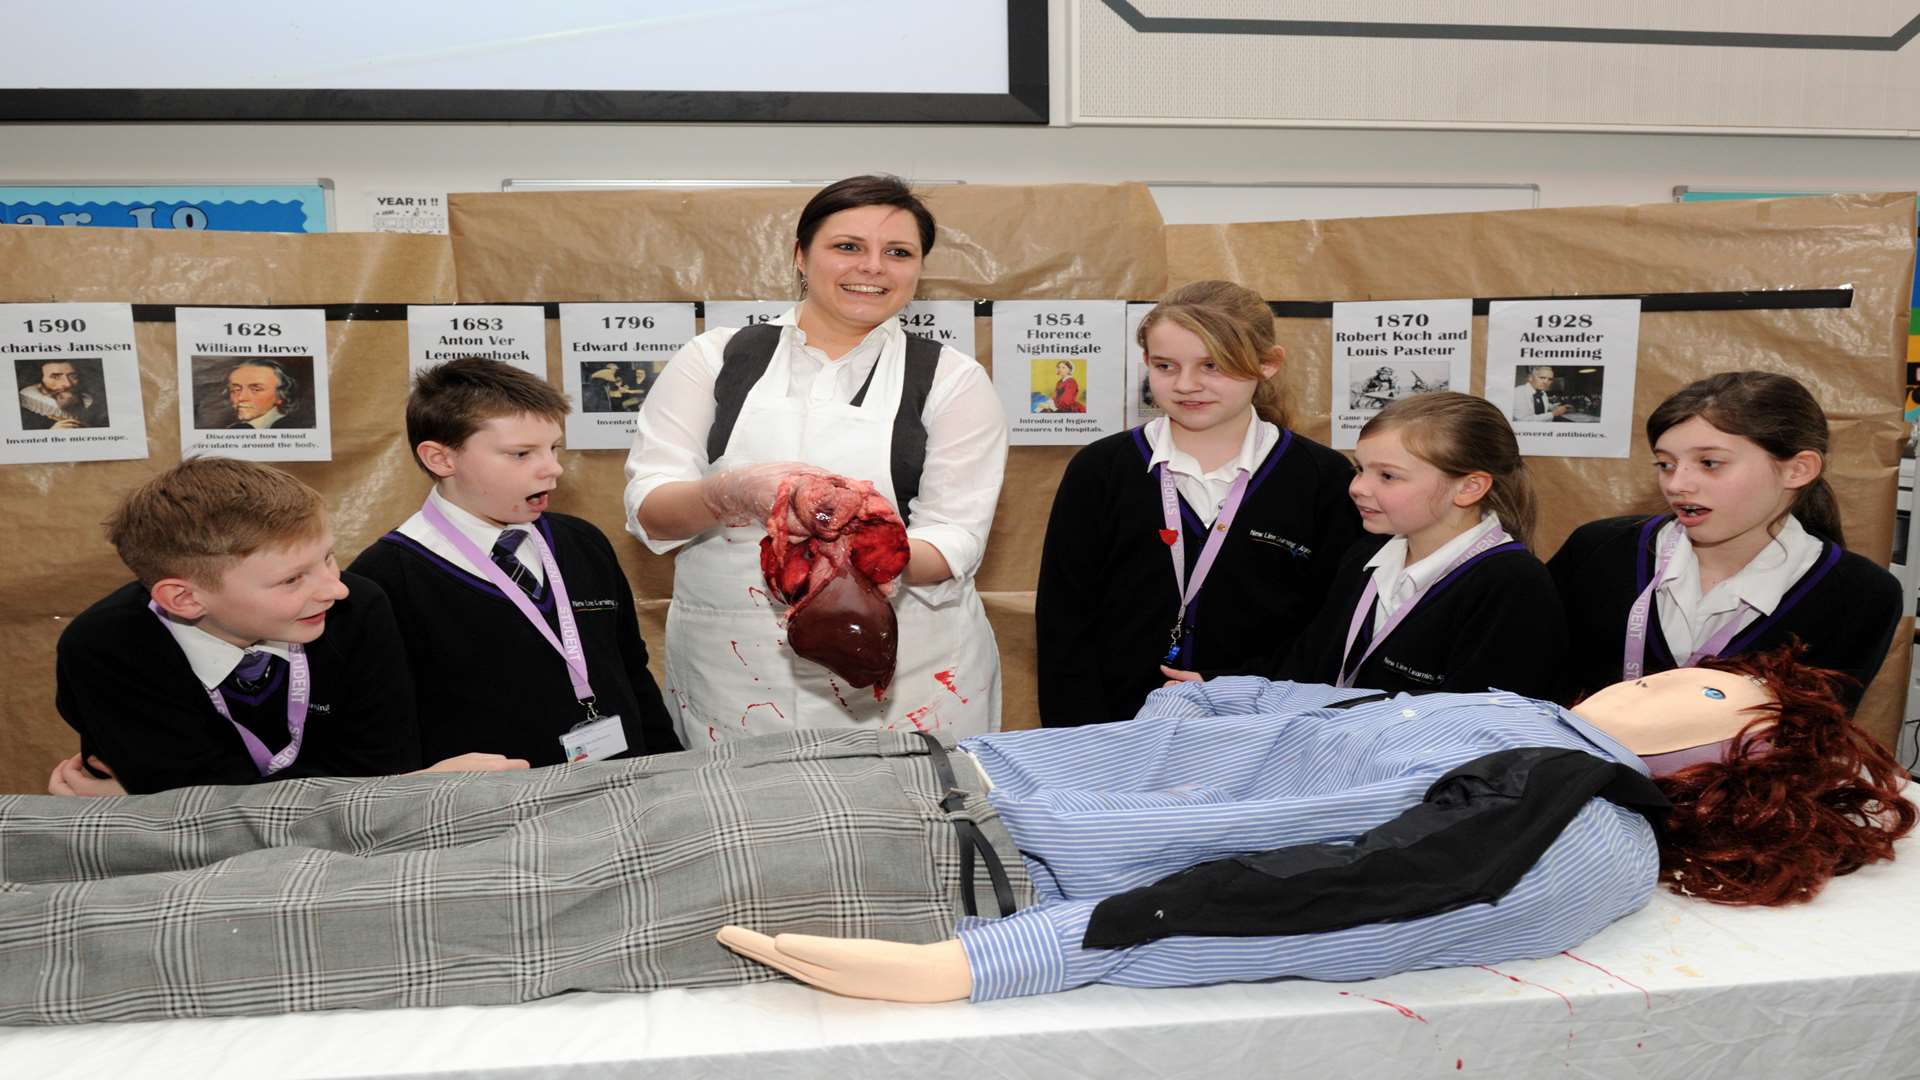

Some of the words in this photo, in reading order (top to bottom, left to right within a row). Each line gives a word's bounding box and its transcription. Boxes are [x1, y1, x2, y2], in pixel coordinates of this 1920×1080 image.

[377, 197, 414, 206] YEAR
[417, 198, 426, 206] 11
[450, 318, 504, 331] 1683
[601, 316, 655, 329] 1796
[898, 314, 935, 327] 842
[1034, 313, 1085, 326] 1854
[1375, 314, 1429, 327] 1870
[1534, 314, 1593, 328] 1928
[24, 319, 86, 333] 1590
[224, 322, 282, 336] 1628
[1027, 330, 1091, 339] Florence
[1336, 332, 1386, 342] Robert
[1393, 331, 1432, 341] Koch
[1438, 330, 1467, 340] and
[1520, 333, 1604, 343] Alexander
[67, 342, 131, 351] Janssen
[439, 336, 483, 346] Anton
[488, 336, 515, 346] Ver
[573, 342, 628, 352] Edward
[195, 343, 252, 353] William
[258, 344, 309, 354] Harvey
[1016, 344, 1102, 355] Nightingale
[1347, 346, 1388, 356] Louis
[1394, 346, 1455, 356] Pasteur
[1520, 348, 1602, 360] Flemming
[560, 606, 581, 661] STUDENT
